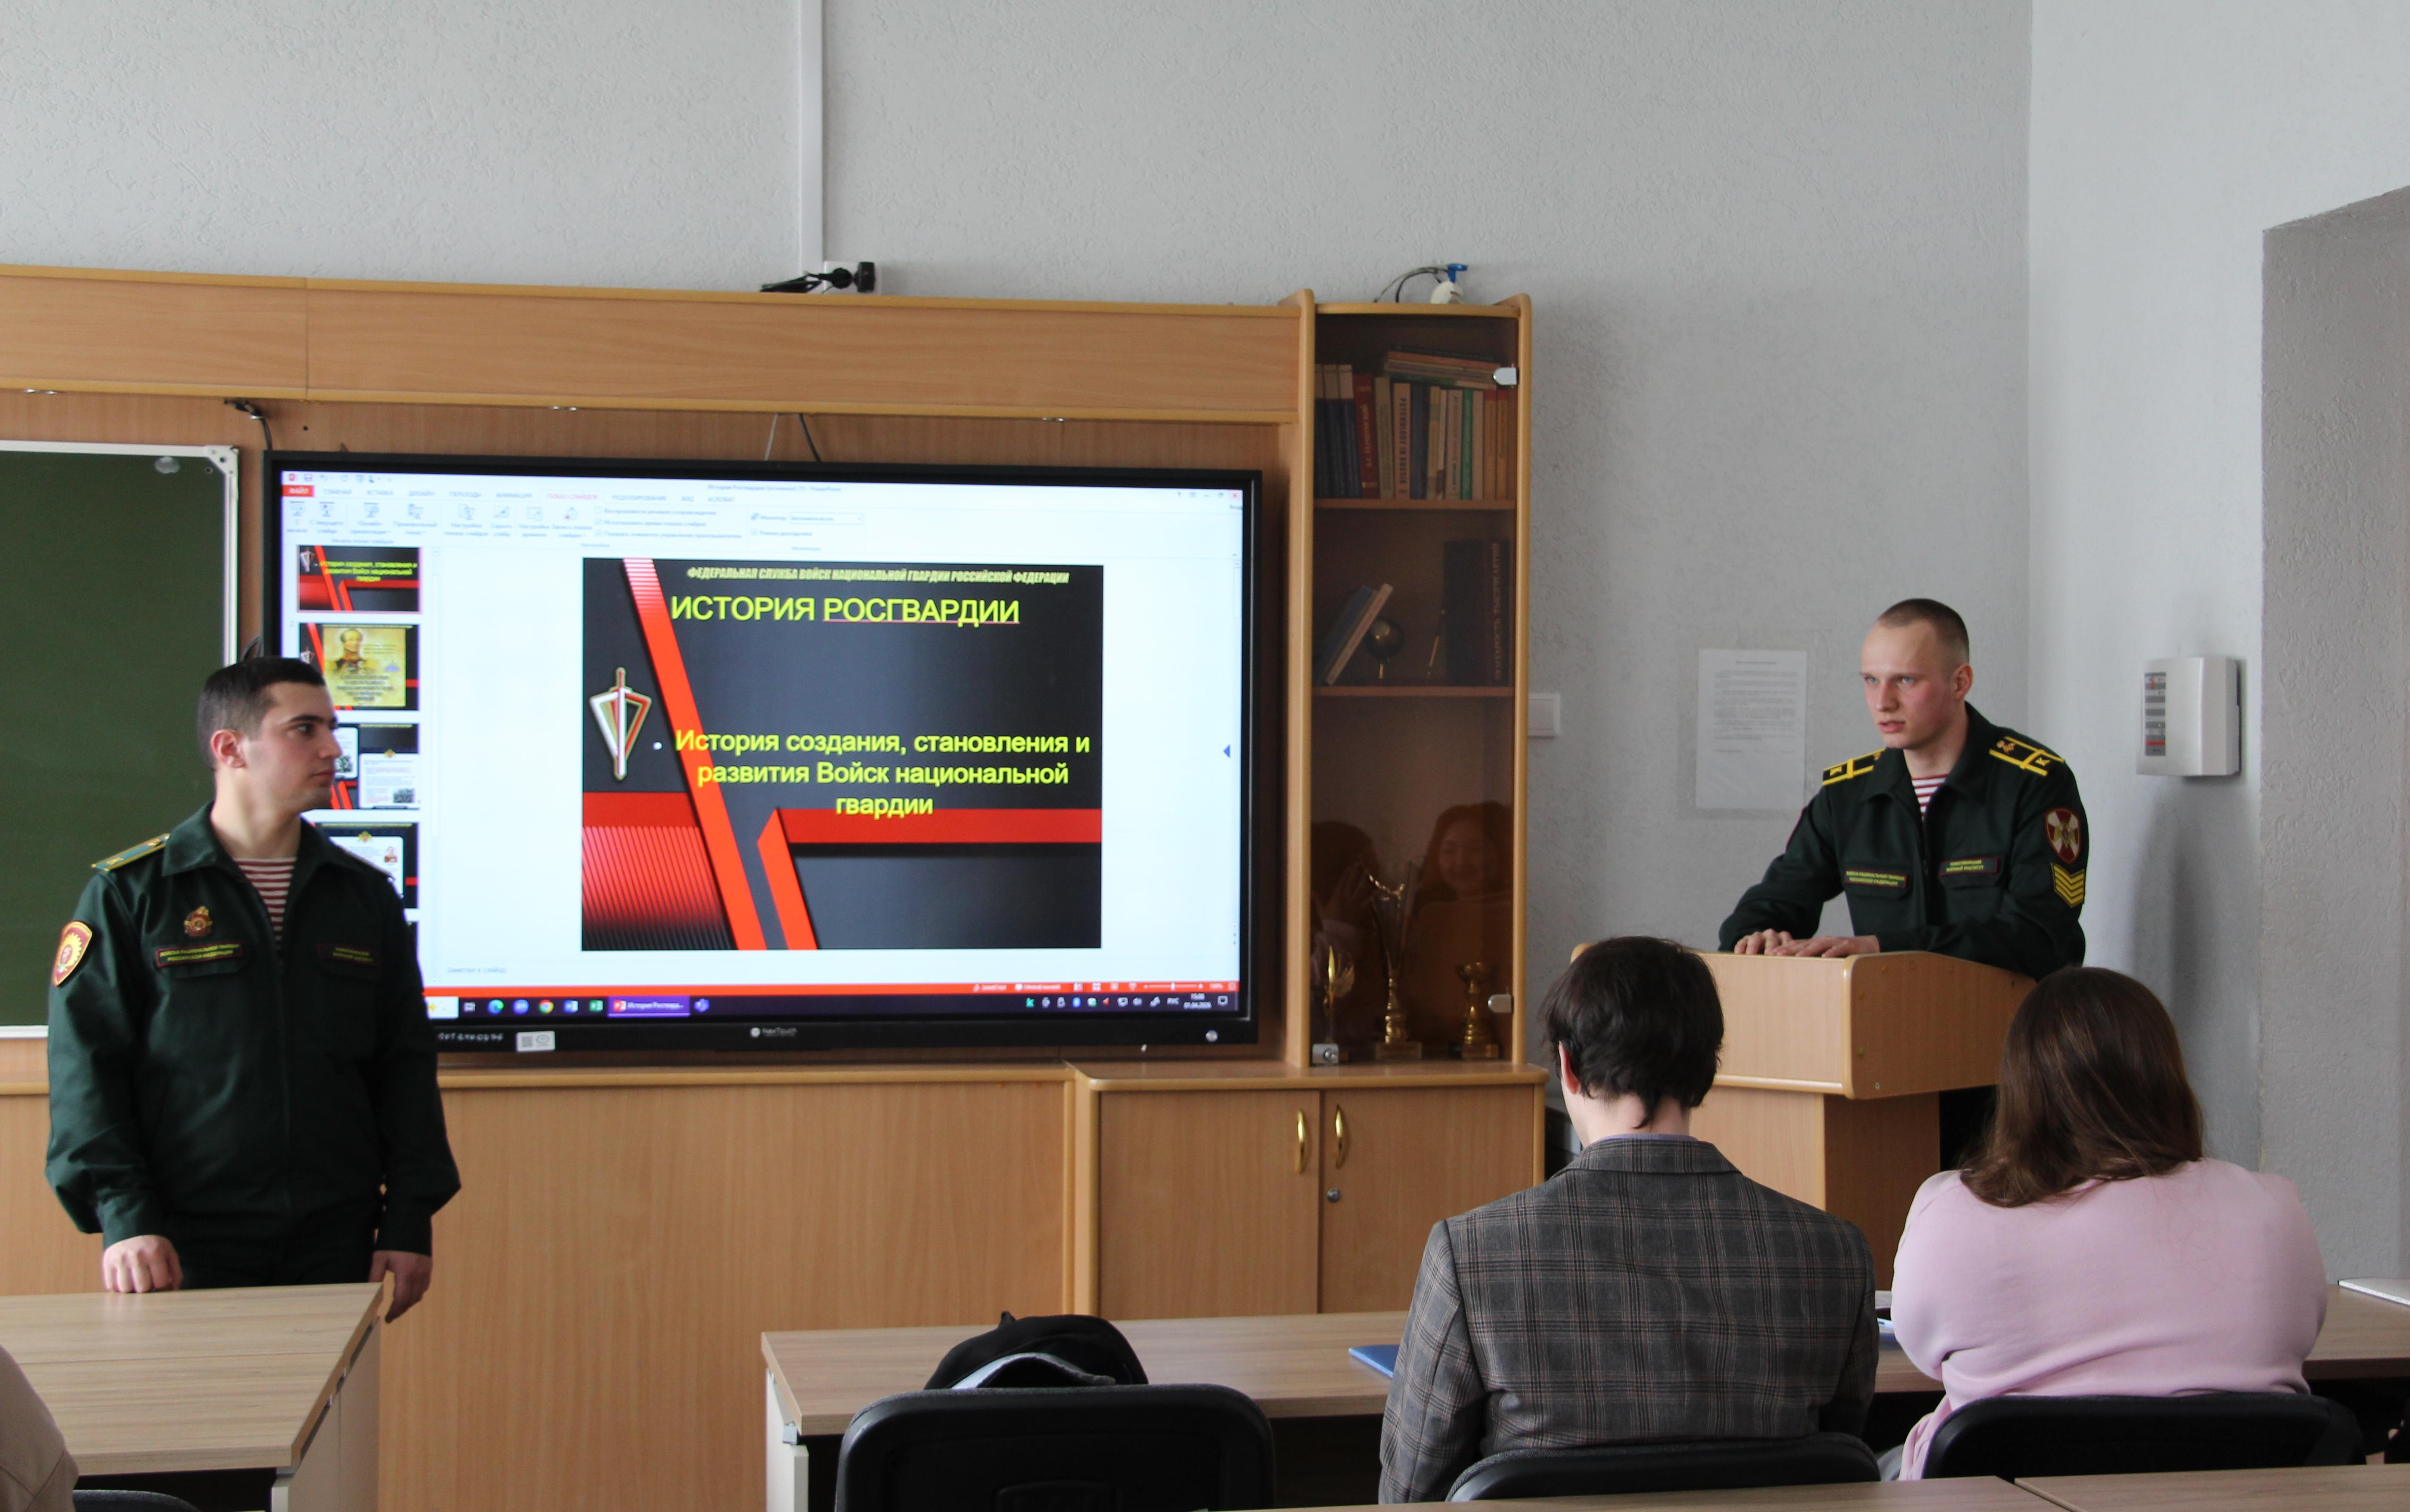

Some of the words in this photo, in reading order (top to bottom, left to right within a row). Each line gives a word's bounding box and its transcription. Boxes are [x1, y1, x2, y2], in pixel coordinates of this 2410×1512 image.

[688, 568, 757, 579] ФЕДЕРАЛЬНАЯ
[758, 569, 798, 579] СЛУЖБА
[799, 569, 830, 579] ВОЙСК
[832, 570, 907, 581] НАЦИОНАЛЬНОЙ
[907, 571, 950, 582] ГВАРДИИ
[950, 570, 1012, 582] РОССИЙСКОЙ
[1013, 572, 1069, 584] ФЕДЕРАЦИИ
[671, 596, 815, 621] ИСТОРИЯ
[824, 597, 1019, 628] РОСГВАРДИИ
[676, 730, 779, 756] История
[786, 735, 906, 755] создания,
[914, 736, 1068, 752] становления
[1076, 737, 1089, 752] и
[698, 764, 810, 787] развития
[817, 761, 890, 783] Войск
[895, 762, 1068, 786] национальной
[836, 797, 933, 820] гвардии
